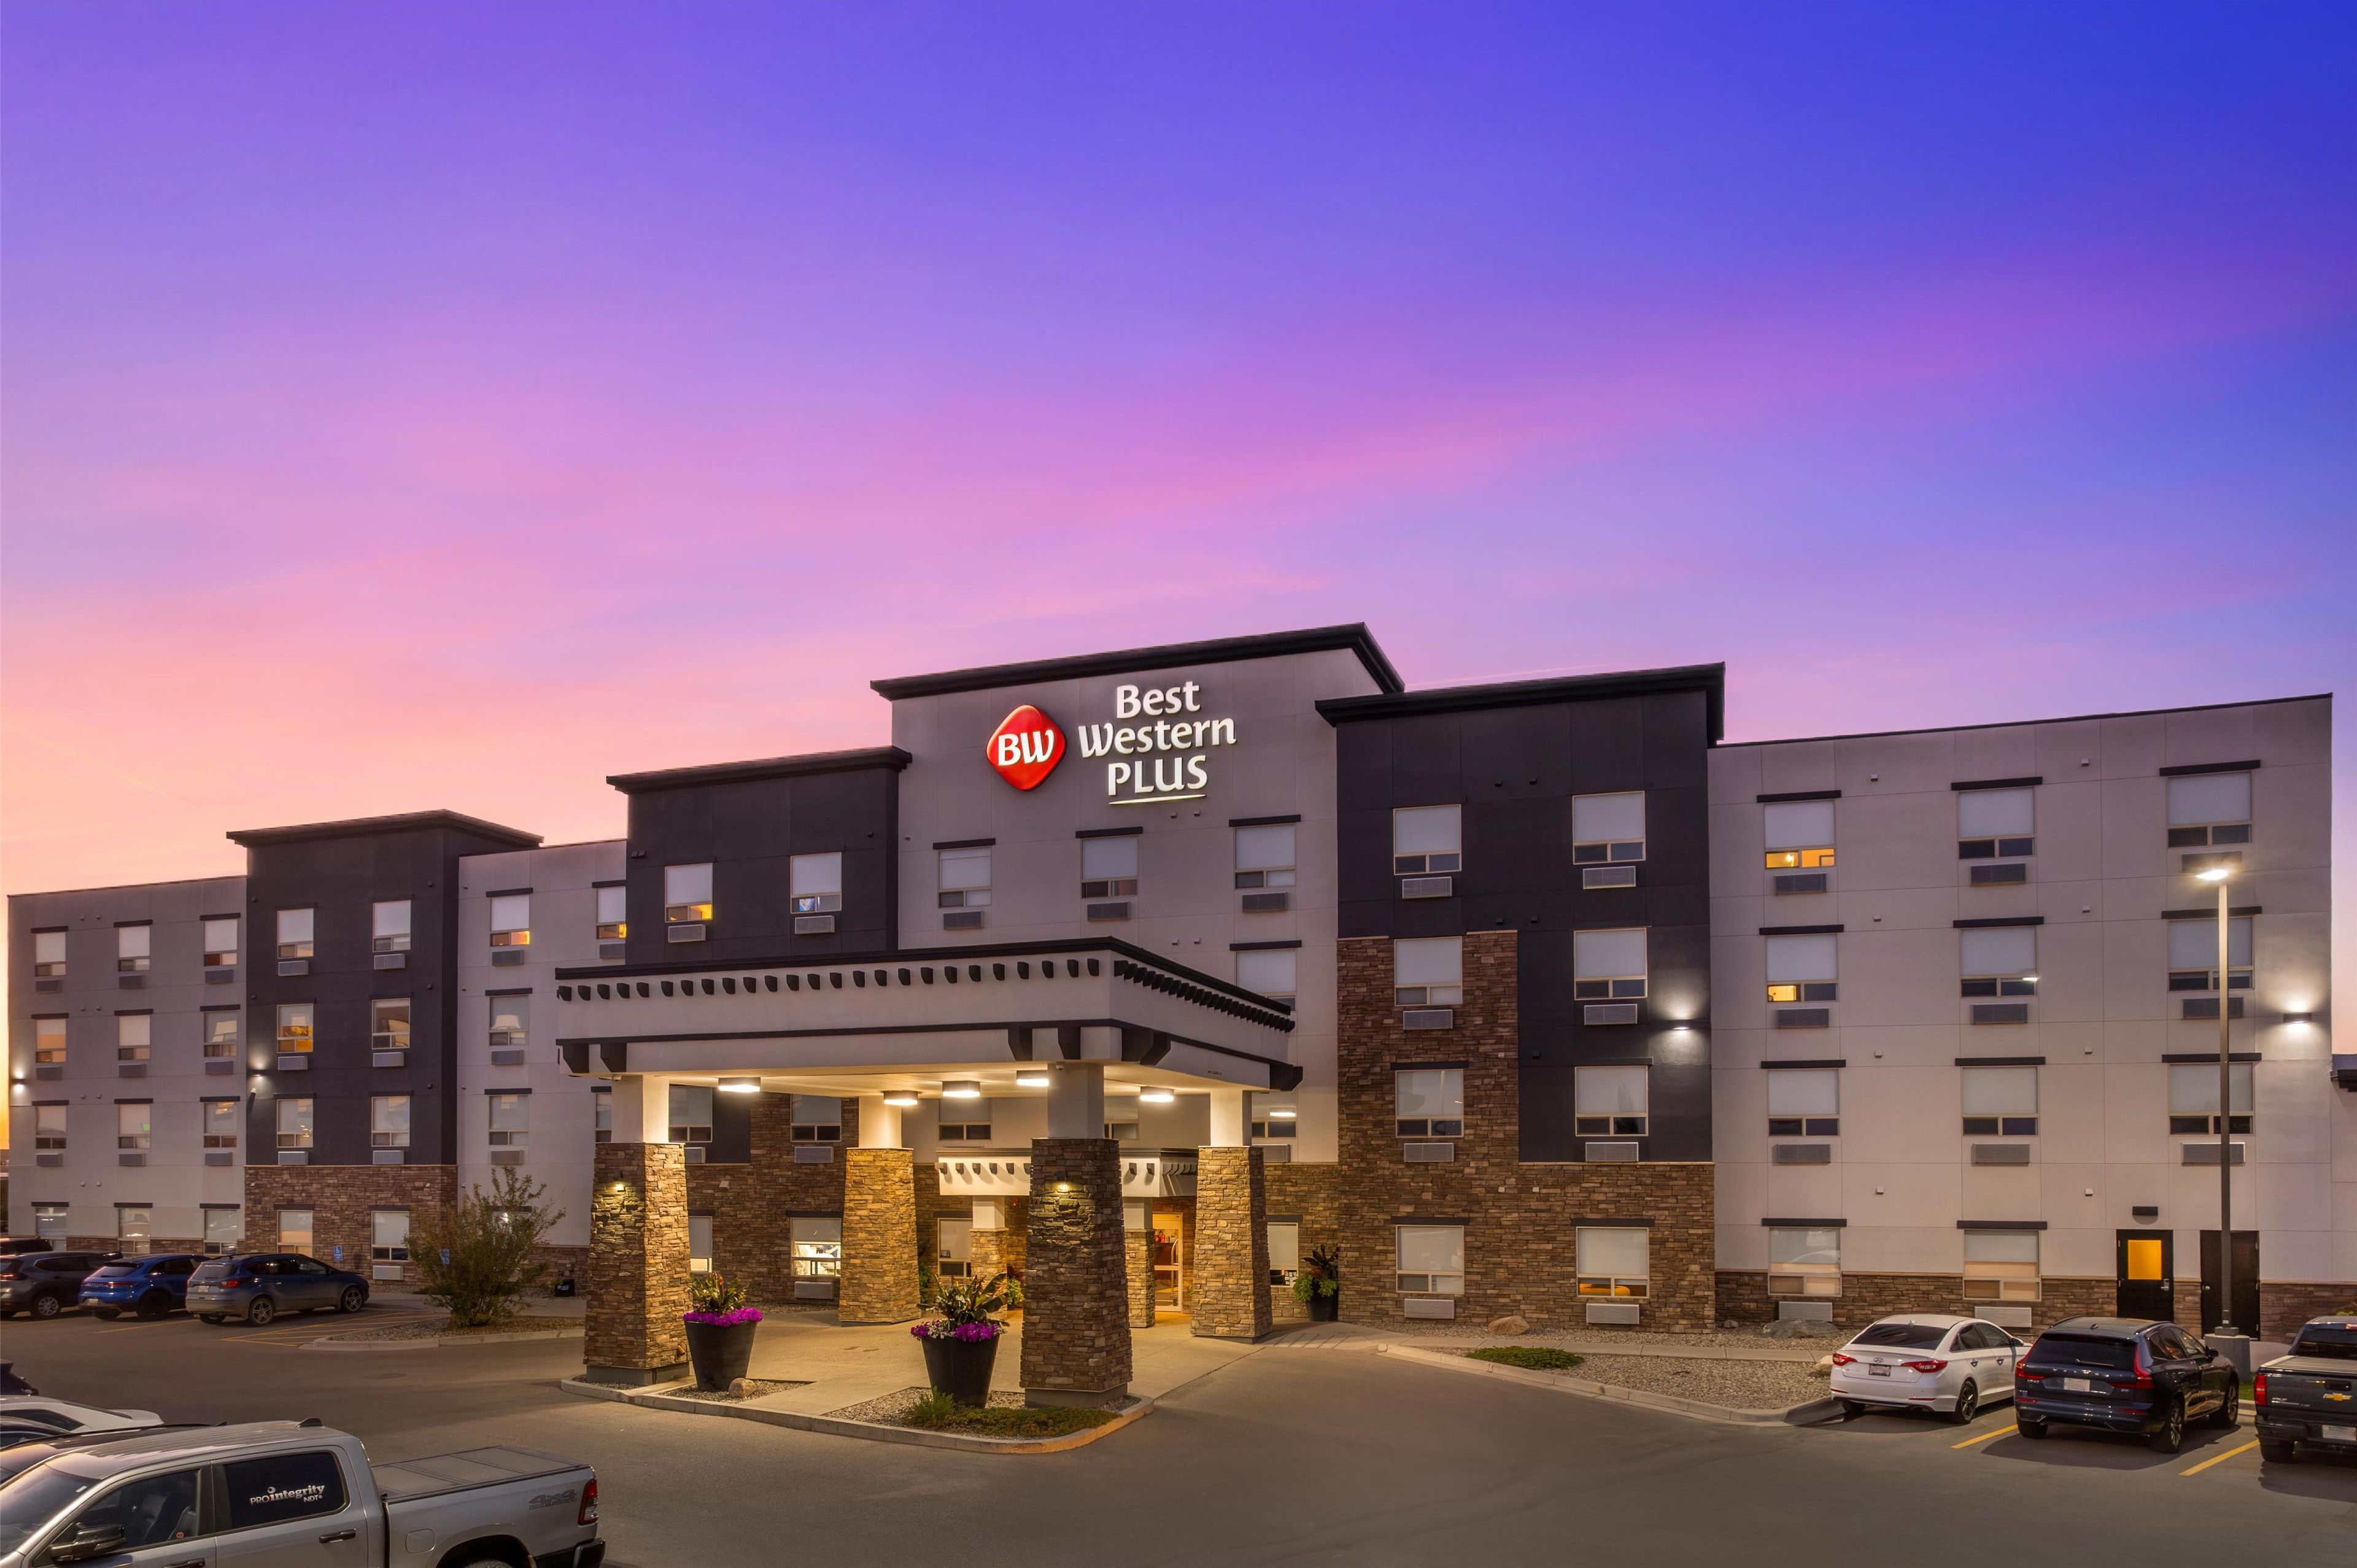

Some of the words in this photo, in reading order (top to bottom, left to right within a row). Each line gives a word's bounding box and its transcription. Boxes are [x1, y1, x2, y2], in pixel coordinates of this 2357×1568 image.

[1117, 681, 1201, 719] Best
[997, 728, 1055, 767] BW
[1078, 717, 1237, 758] Western
[1108, 755, 1208, 797] PLUS
